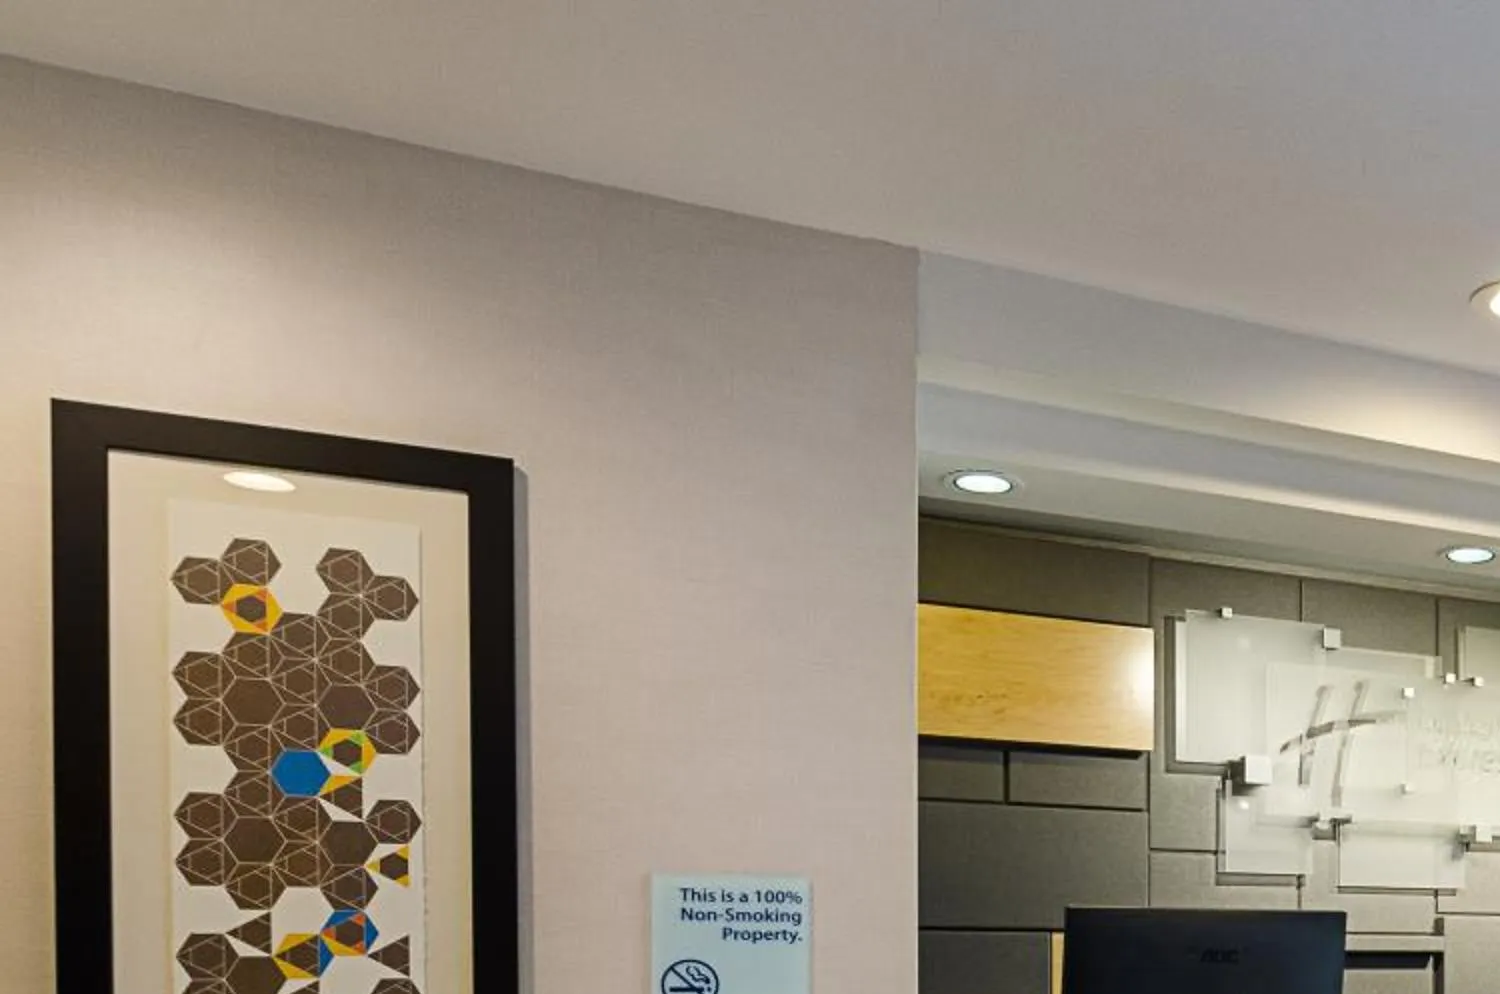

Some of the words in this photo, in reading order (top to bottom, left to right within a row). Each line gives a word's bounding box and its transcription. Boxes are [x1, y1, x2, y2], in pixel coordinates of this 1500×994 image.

[680, 887, 717, 903] This
[721, 889, 735, 903] is
[739, 893, 749, 903] a
[755, 890, 803, 905] 100%
[680, 907, 803, 926] Non-Smoking
[722, 927, 803, 944] Property.
